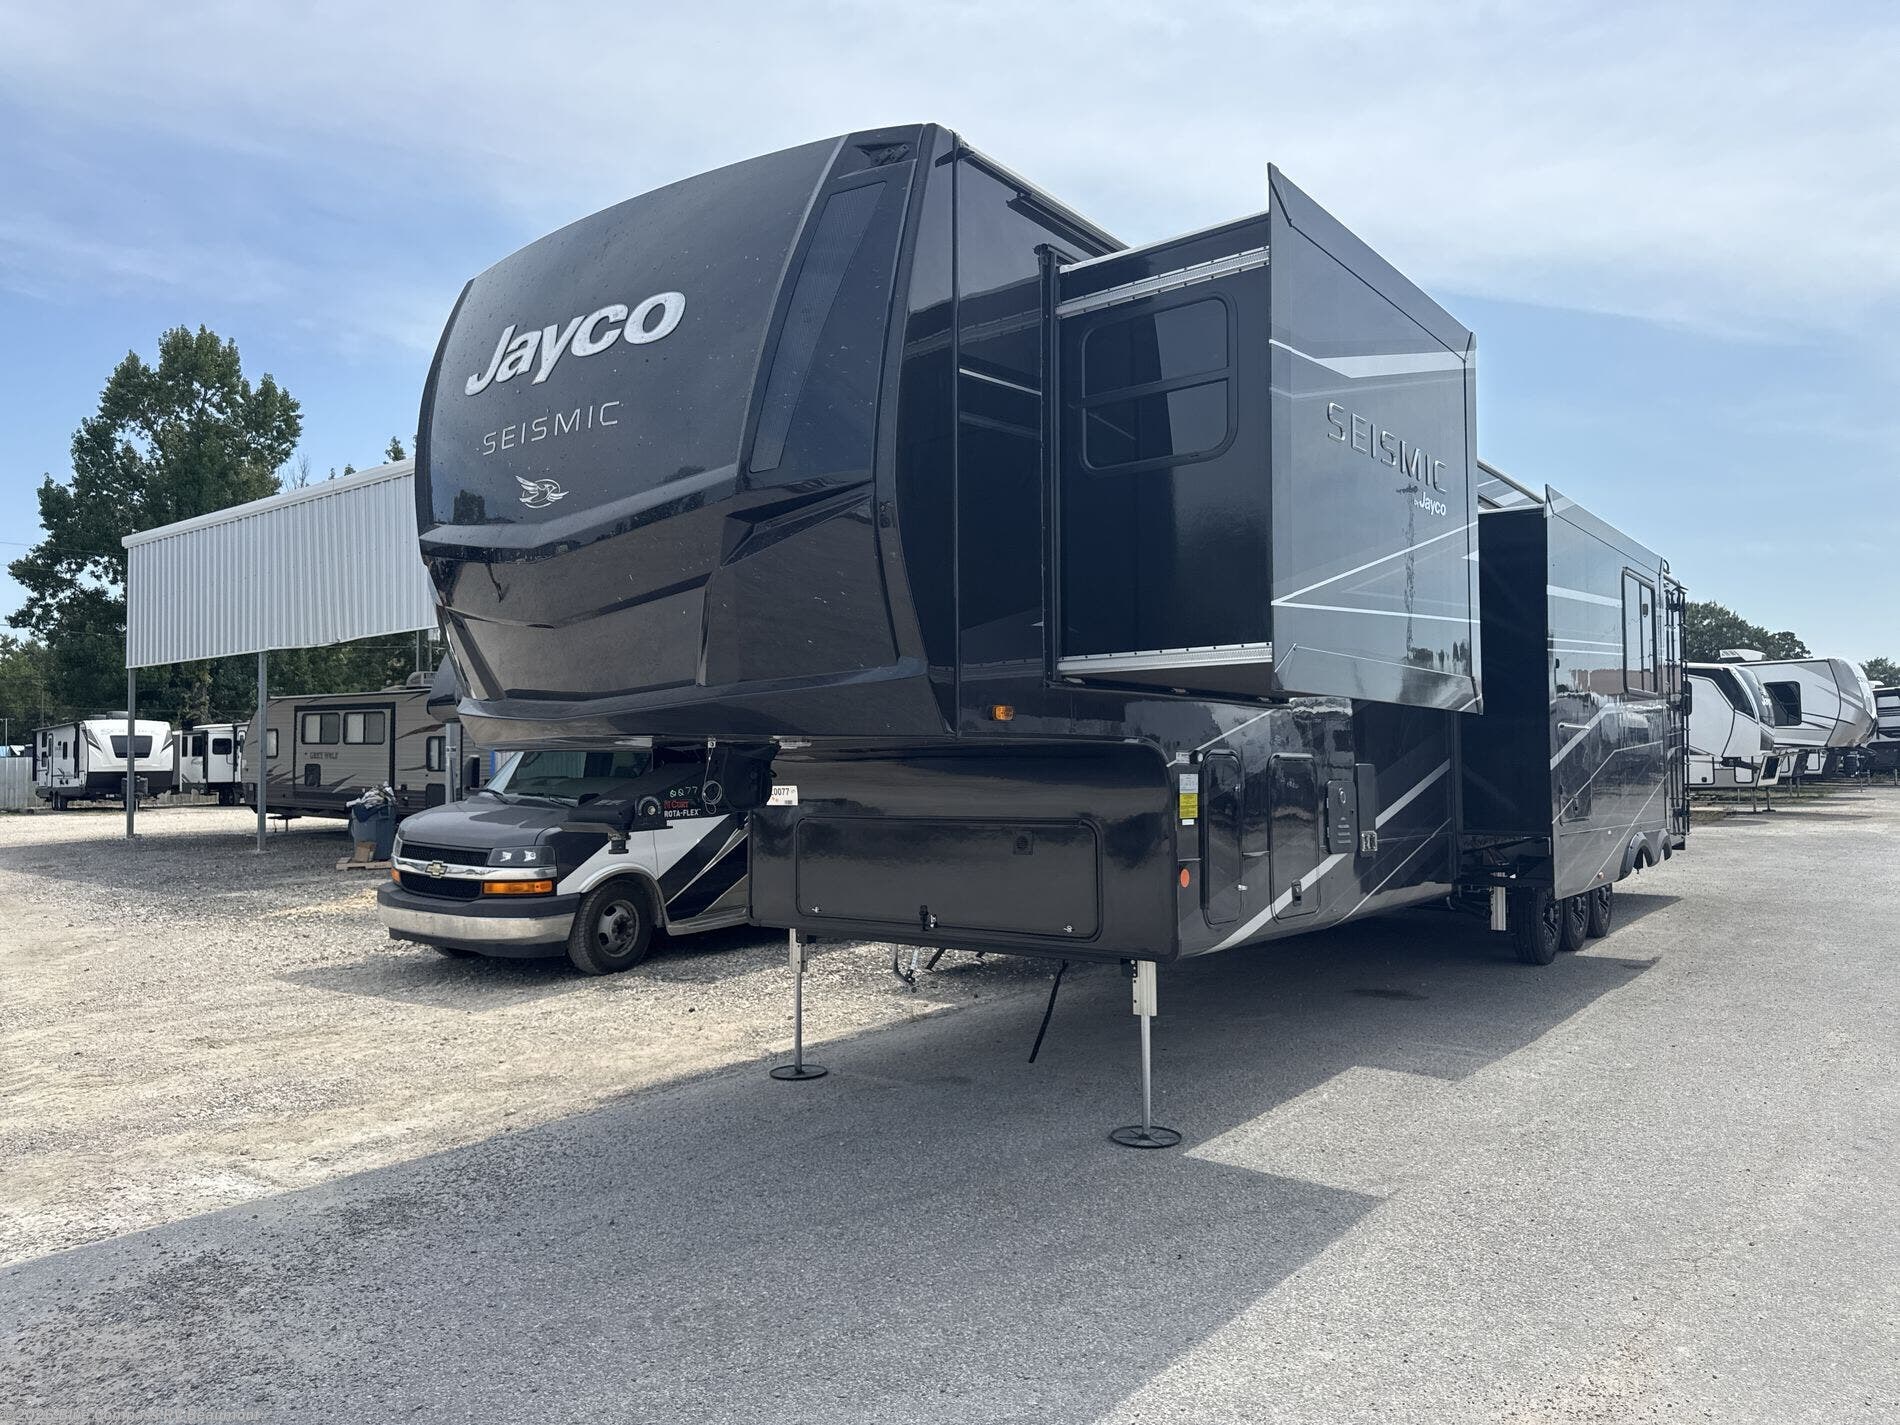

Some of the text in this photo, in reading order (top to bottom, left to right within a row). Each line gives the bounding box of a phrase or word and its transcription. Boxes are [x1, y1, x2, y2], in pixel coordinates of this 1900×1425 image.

[464, 291, 686, 396] Jayco
[482, 400, 620, 456] SEISMIC
[1326, 401, 1448, 496] SEISMIC
[1420, 491, 1447, 516] Jayco
[771, 787, 790, 796] 0077
